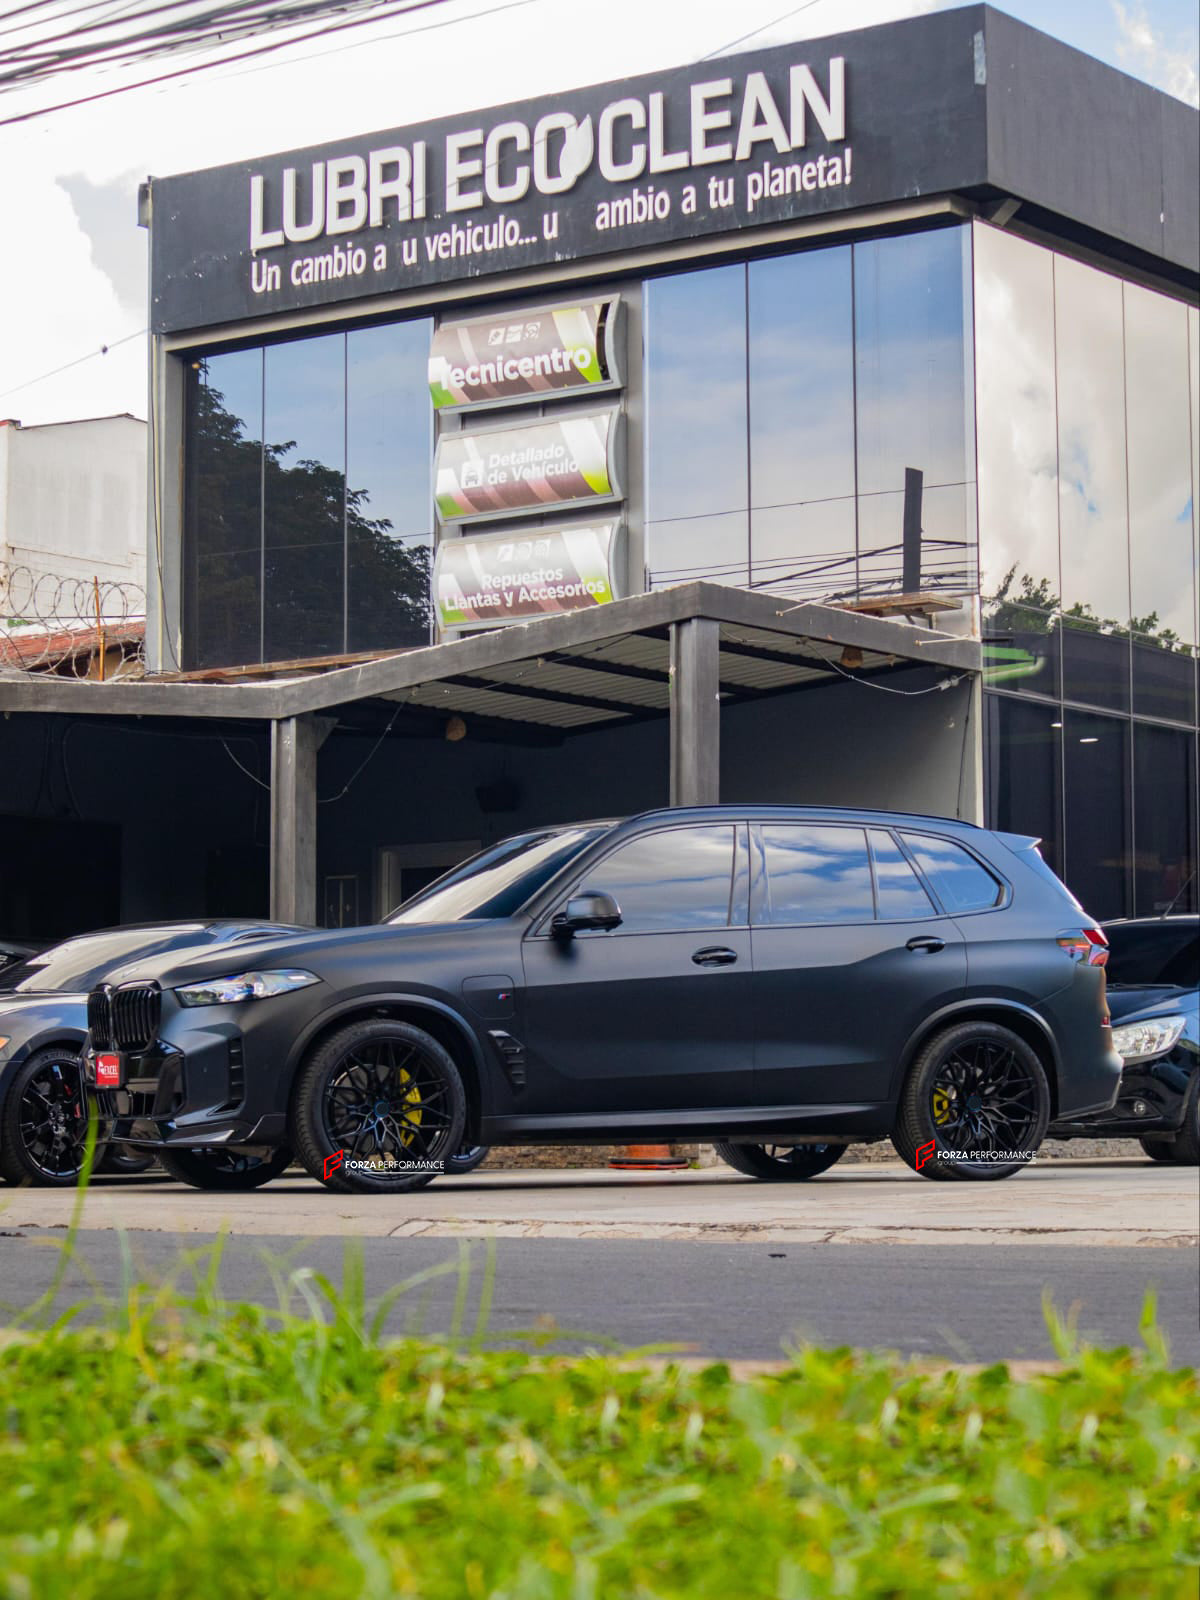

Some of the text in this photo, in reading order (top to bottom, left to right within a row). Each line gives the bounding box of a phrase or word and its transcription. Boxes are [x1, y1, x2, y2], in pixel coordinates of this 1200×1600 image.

[250, 140, 427, 250] LUBRI
[251, 261, 281, 293] Un
[290, 241, 367, 287] cambio
[373, 243, 387, 272] a
[595, 186, 671, 232] ambio
[681, 185, 697, 215] a
[707, 175, 735, 210] tu
[746, 147, 853, 213] planeta!
[436, 347, 592, 391] Tecnicentro
[488, 443, 565, 469] Detallado
[487, 469, 508, 485] de
[444, 579, 606, 611] Llantas y Accesorios
[481, 567, 564, 591] Repuestos
